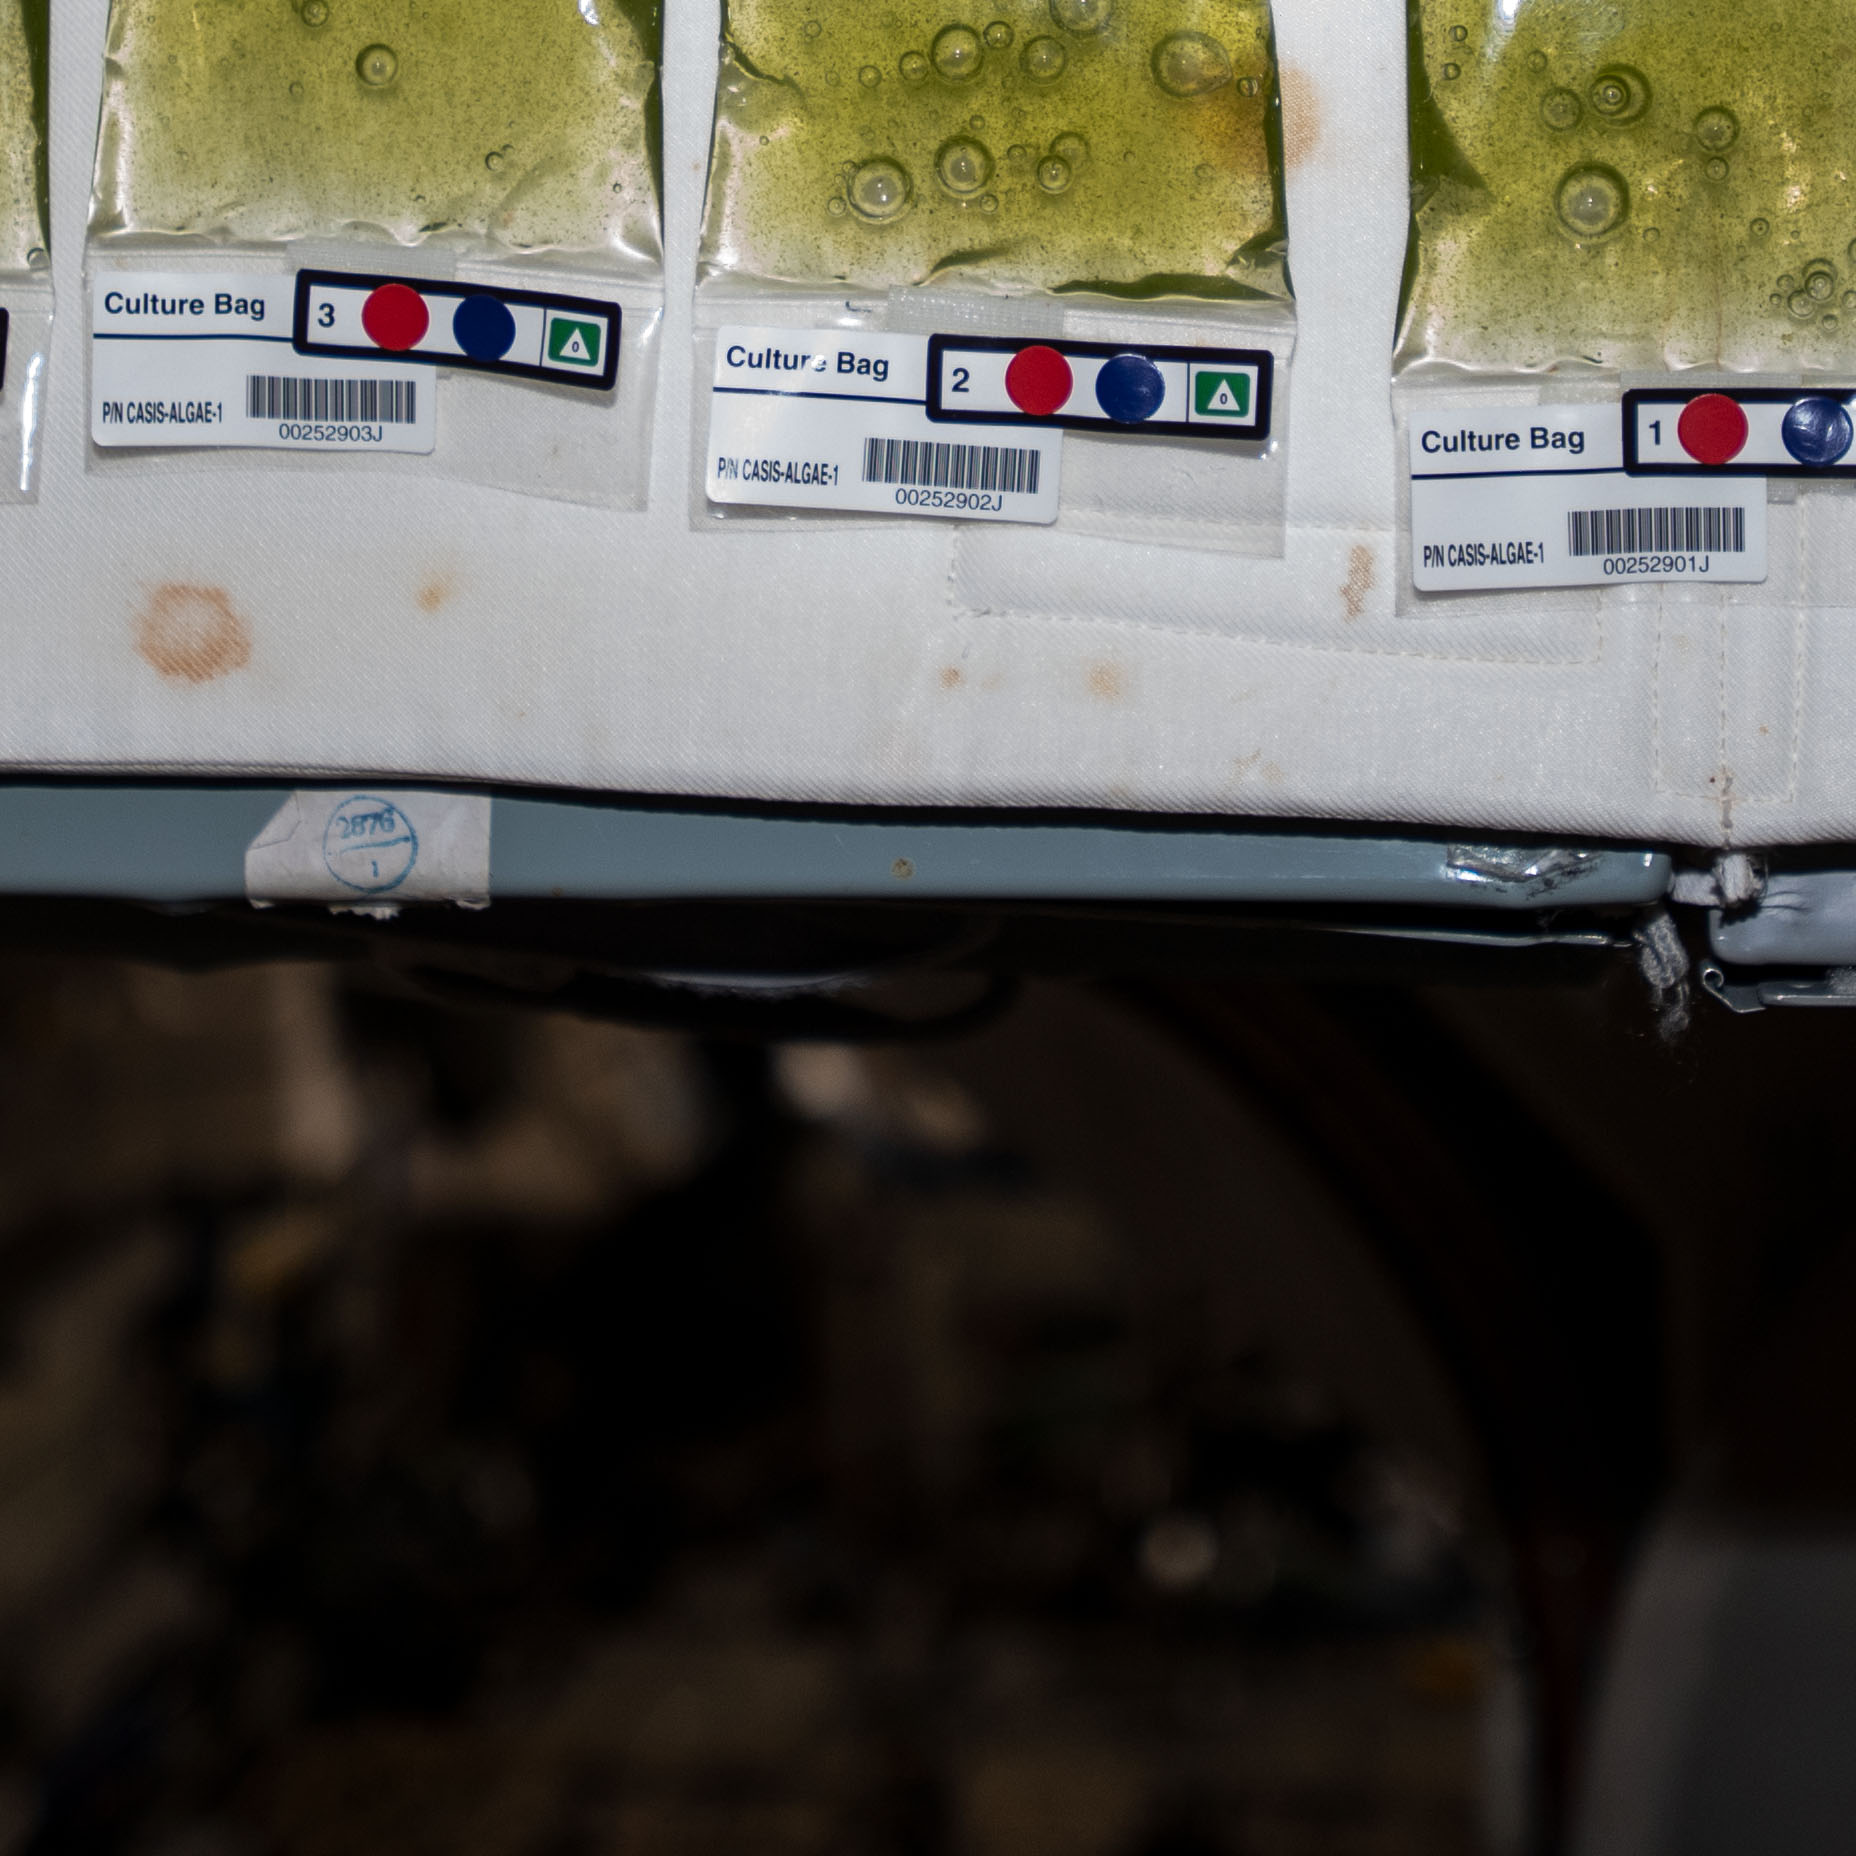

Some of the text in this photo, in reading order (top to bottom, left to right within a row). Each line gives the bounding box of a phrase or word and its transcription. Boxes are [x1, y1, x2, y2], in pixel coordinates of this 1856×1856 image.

[104, 292, 266, 321] Culture Bag
[317, 304, 336, 328] 3
[572, 341, 580, 353] 0
[726, 345, 889, 382] Culture Bag
[951, 369, 970, 393] 2
[1219, 393, 1228, 405] 0
[102, 401, 223, 425] P/N CASIS-ALGAE-1
[279, 423, 383, 443] 00252903J
[1421, 425, 1586, 455] Culture Bag
[1648, 420, 1663, 445] 1
[717, 457, 839, 488] P/N CASIS-ALGAE-1
[895, 489, 1003, 513] 00252902J
[1423, 541, 1545, 568] P/N CASIS-ALGAE-1
[1603, 554, 1711, 575] 00252901J
